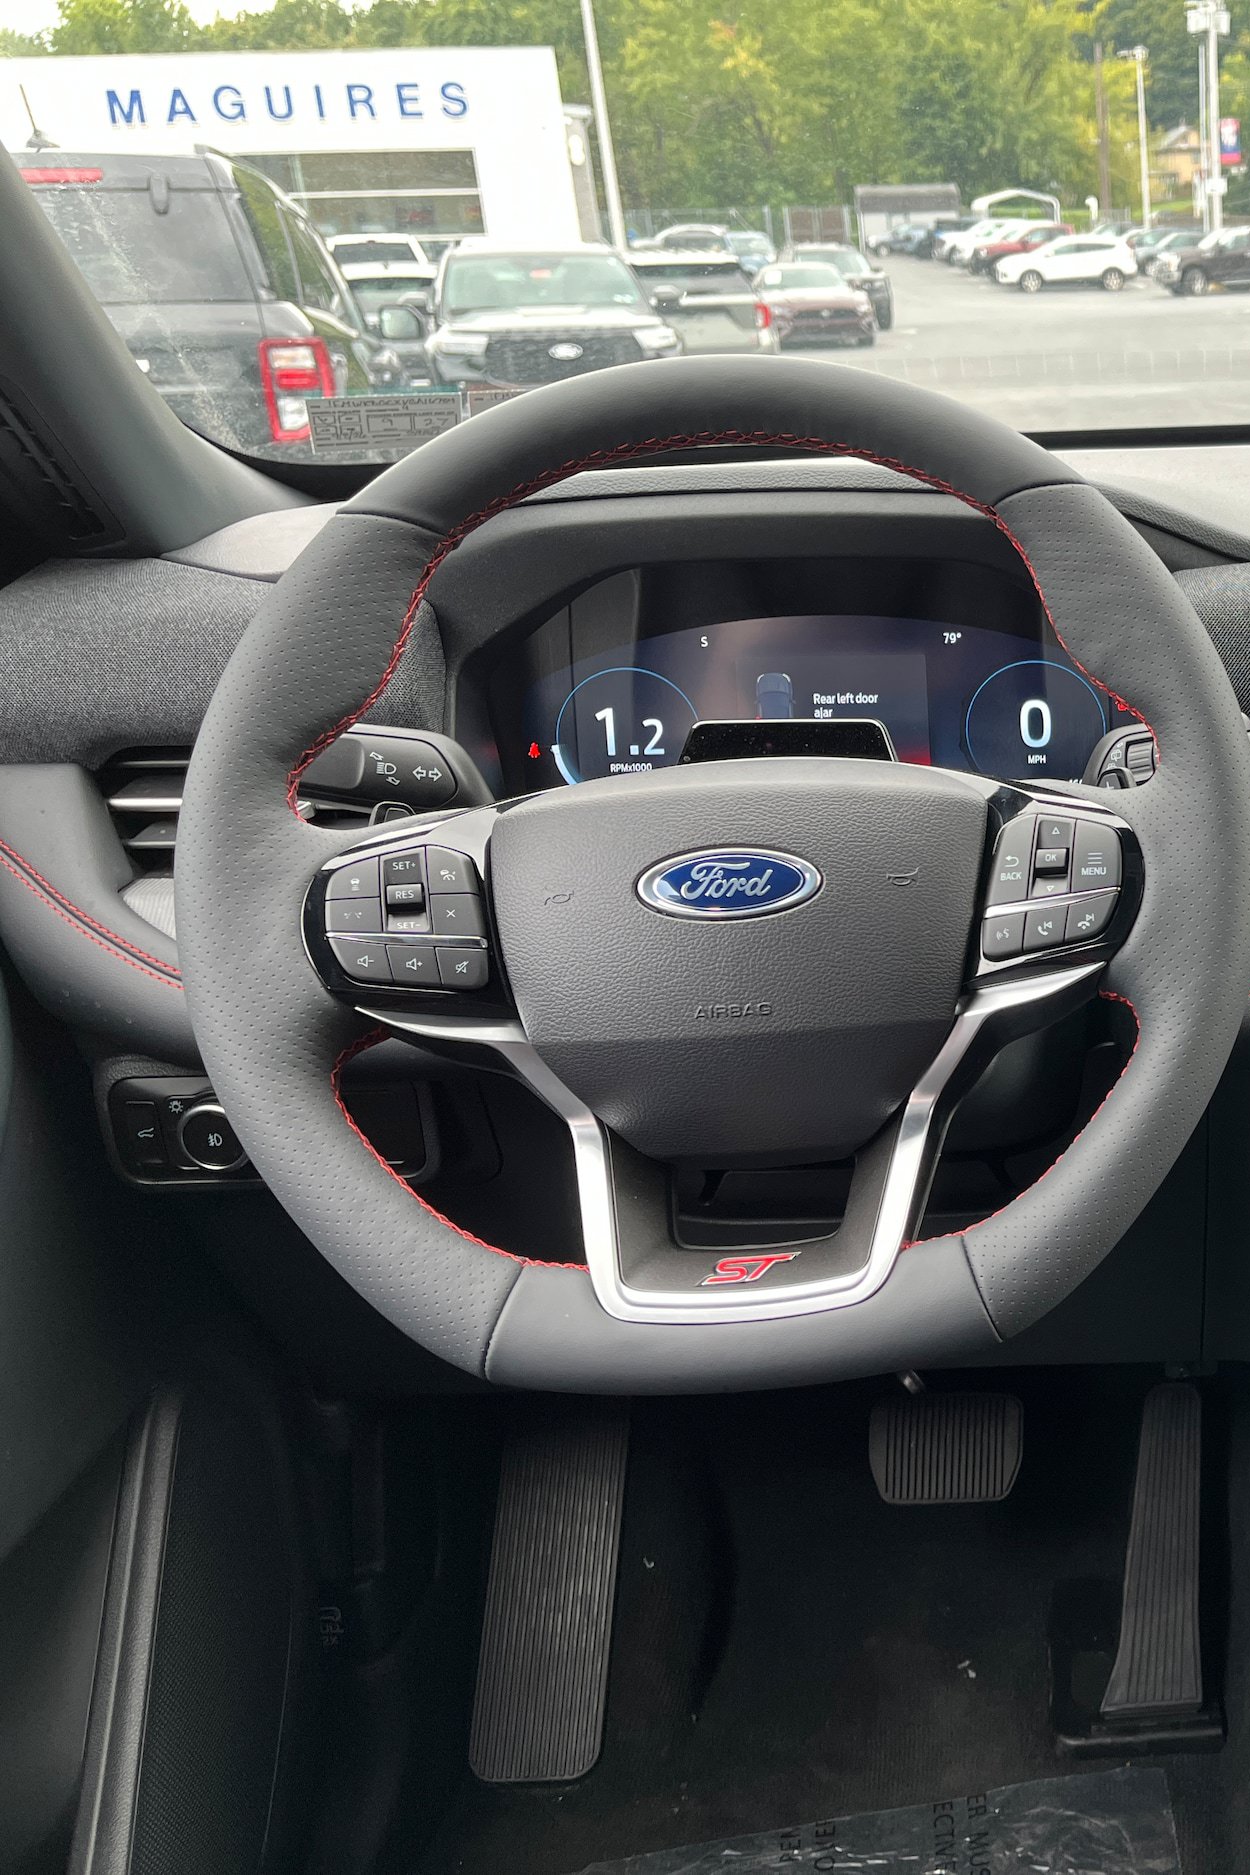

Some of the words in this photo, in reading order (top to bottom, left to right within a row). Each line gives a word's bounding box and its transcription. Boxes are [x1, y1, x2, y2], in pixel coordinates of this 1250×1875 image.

[106, 82, 469, 125] MAGUIRES
[700, 636, 708, 647] S
[943, 632, 962, 644] 79°
[813, 693, 836, 705] Rear
[837, 692, 854, 704] left
[855, 692, 878, 704] door
[814, 707, 833, 719] ajar
[1019, 699, 1051, 748] 0
[594, 707, 665, 756] 1.2
[1027, 754, 1046, 764] MPH
[610, 763, 652, 773] RPMx1000
[1045, 853, 1057, 862] OK
[1000, 871, 1022, 881] BACK
[1081, 867, 1107, 876] MENU
[680, 862, 774, 900] Ford
[395, 890, 415, 899] RES
[694, 1001, 773, 1020] AIRBAG
[701, 1251, 802, 1286] ST
